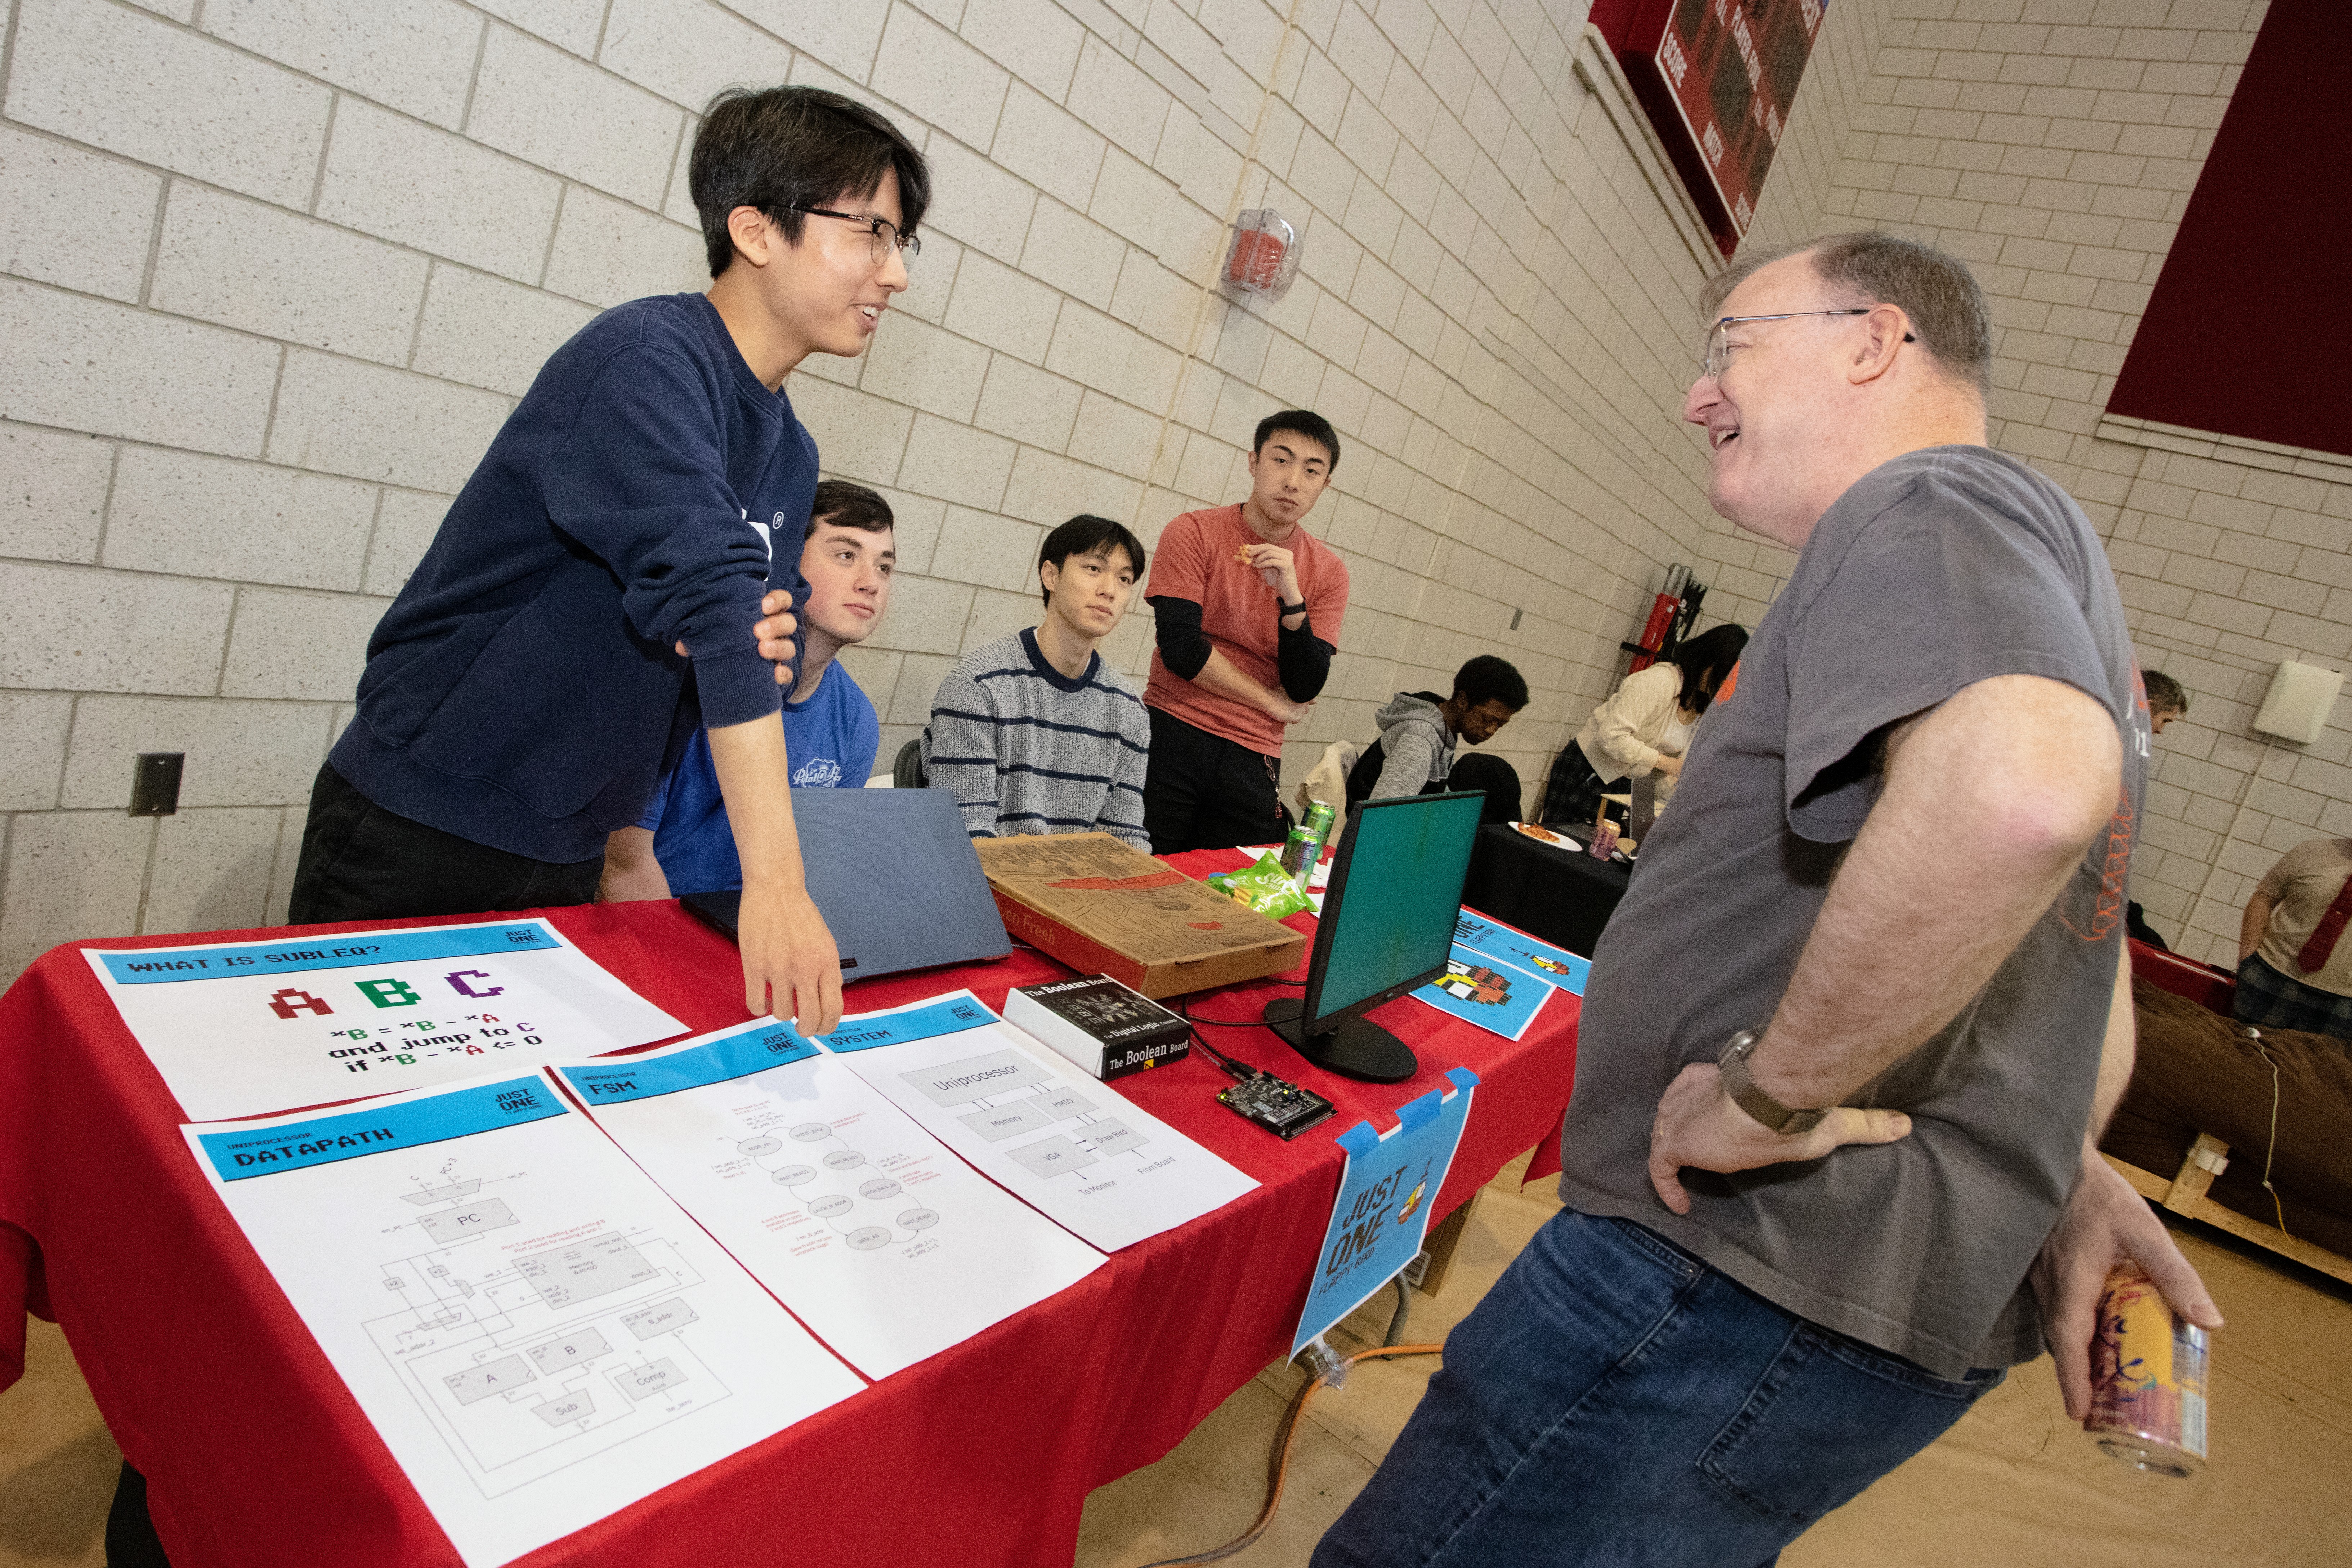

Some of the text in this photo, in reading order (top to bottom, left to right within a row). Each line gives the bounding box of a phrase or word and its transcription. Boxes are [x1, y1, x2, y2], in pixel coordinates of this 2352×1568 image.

[1731, 4, 1762, 91] PLAYER FOUL
[1663, 32, 1688, 89] SCORE
[1703, 121, 1724, 169] MATCH
[1735, 192, 1753, 231] SCORE
[1023, 913, 1055, 946] Fresh
[1469, 933, 1488, 944] FLAPPY
[128, 945, 381, 972] WHAT IS SUBLEQ?
[268, 970, 505, 1019] A B C
[1024, 977, 1112, 998] The Boolean Board
[951, 1005, 970, 1014] JUST
[955, 1010, 979, 1019] ONE
[1112, 1025, 1137, 1038] Digital
[1136, 1021, 1160, 1034] Logic
[328, 1022, 536, 1059] and jump to C
[762, 1032, 789, 1046] JUST
[830, 1030, 893, 1045] SYSTEM
[767, 1038, 796, 1053] ONE
[1109, 1039, 1188, 1070] The Boolean Board
[344, 1059, 370, 1073] if
[581, 1071, 638, 1081] UNIPROCESSOR
[933, 1065, 1019, 1090] Uniprocessor
[588, 1080, 638, 1095] FSM
[495, 1088, 530, 1103] JUST
[1052, 1098, 1074, 1107] MMIO
[498, 1095, 540, 1112] ONE
[505, 1107, 529, 1115] FLAPPY
[991, 1116, 1023, 1127] Memory
[227, 1132, 313, 1150] UNIPROCESSOR
[1095, 1129, 1128, 1143] Draw Bird
[233, 1127, 395, 1167] DATAPATH
[1043, 1152, 1060, 1161] VGA
[1137, 1156, 1176, 1174] From Board
[1088, 1180, 1116, 1192] Monitor
[1342, 1165, 1408, 1230] JUST
[457, 1214, 481, 1225] PC
[1325, 1203, 1393, 1278] ONE
[1317, 1245, 1375, 1299] FLAPPY BIRD
[564, 1346, 576, 1355] B
[487, 1374, 497, 1384] A
[636, 1371, 666, 1386] Comp
[555, 1403, 578, 1415] Sub
